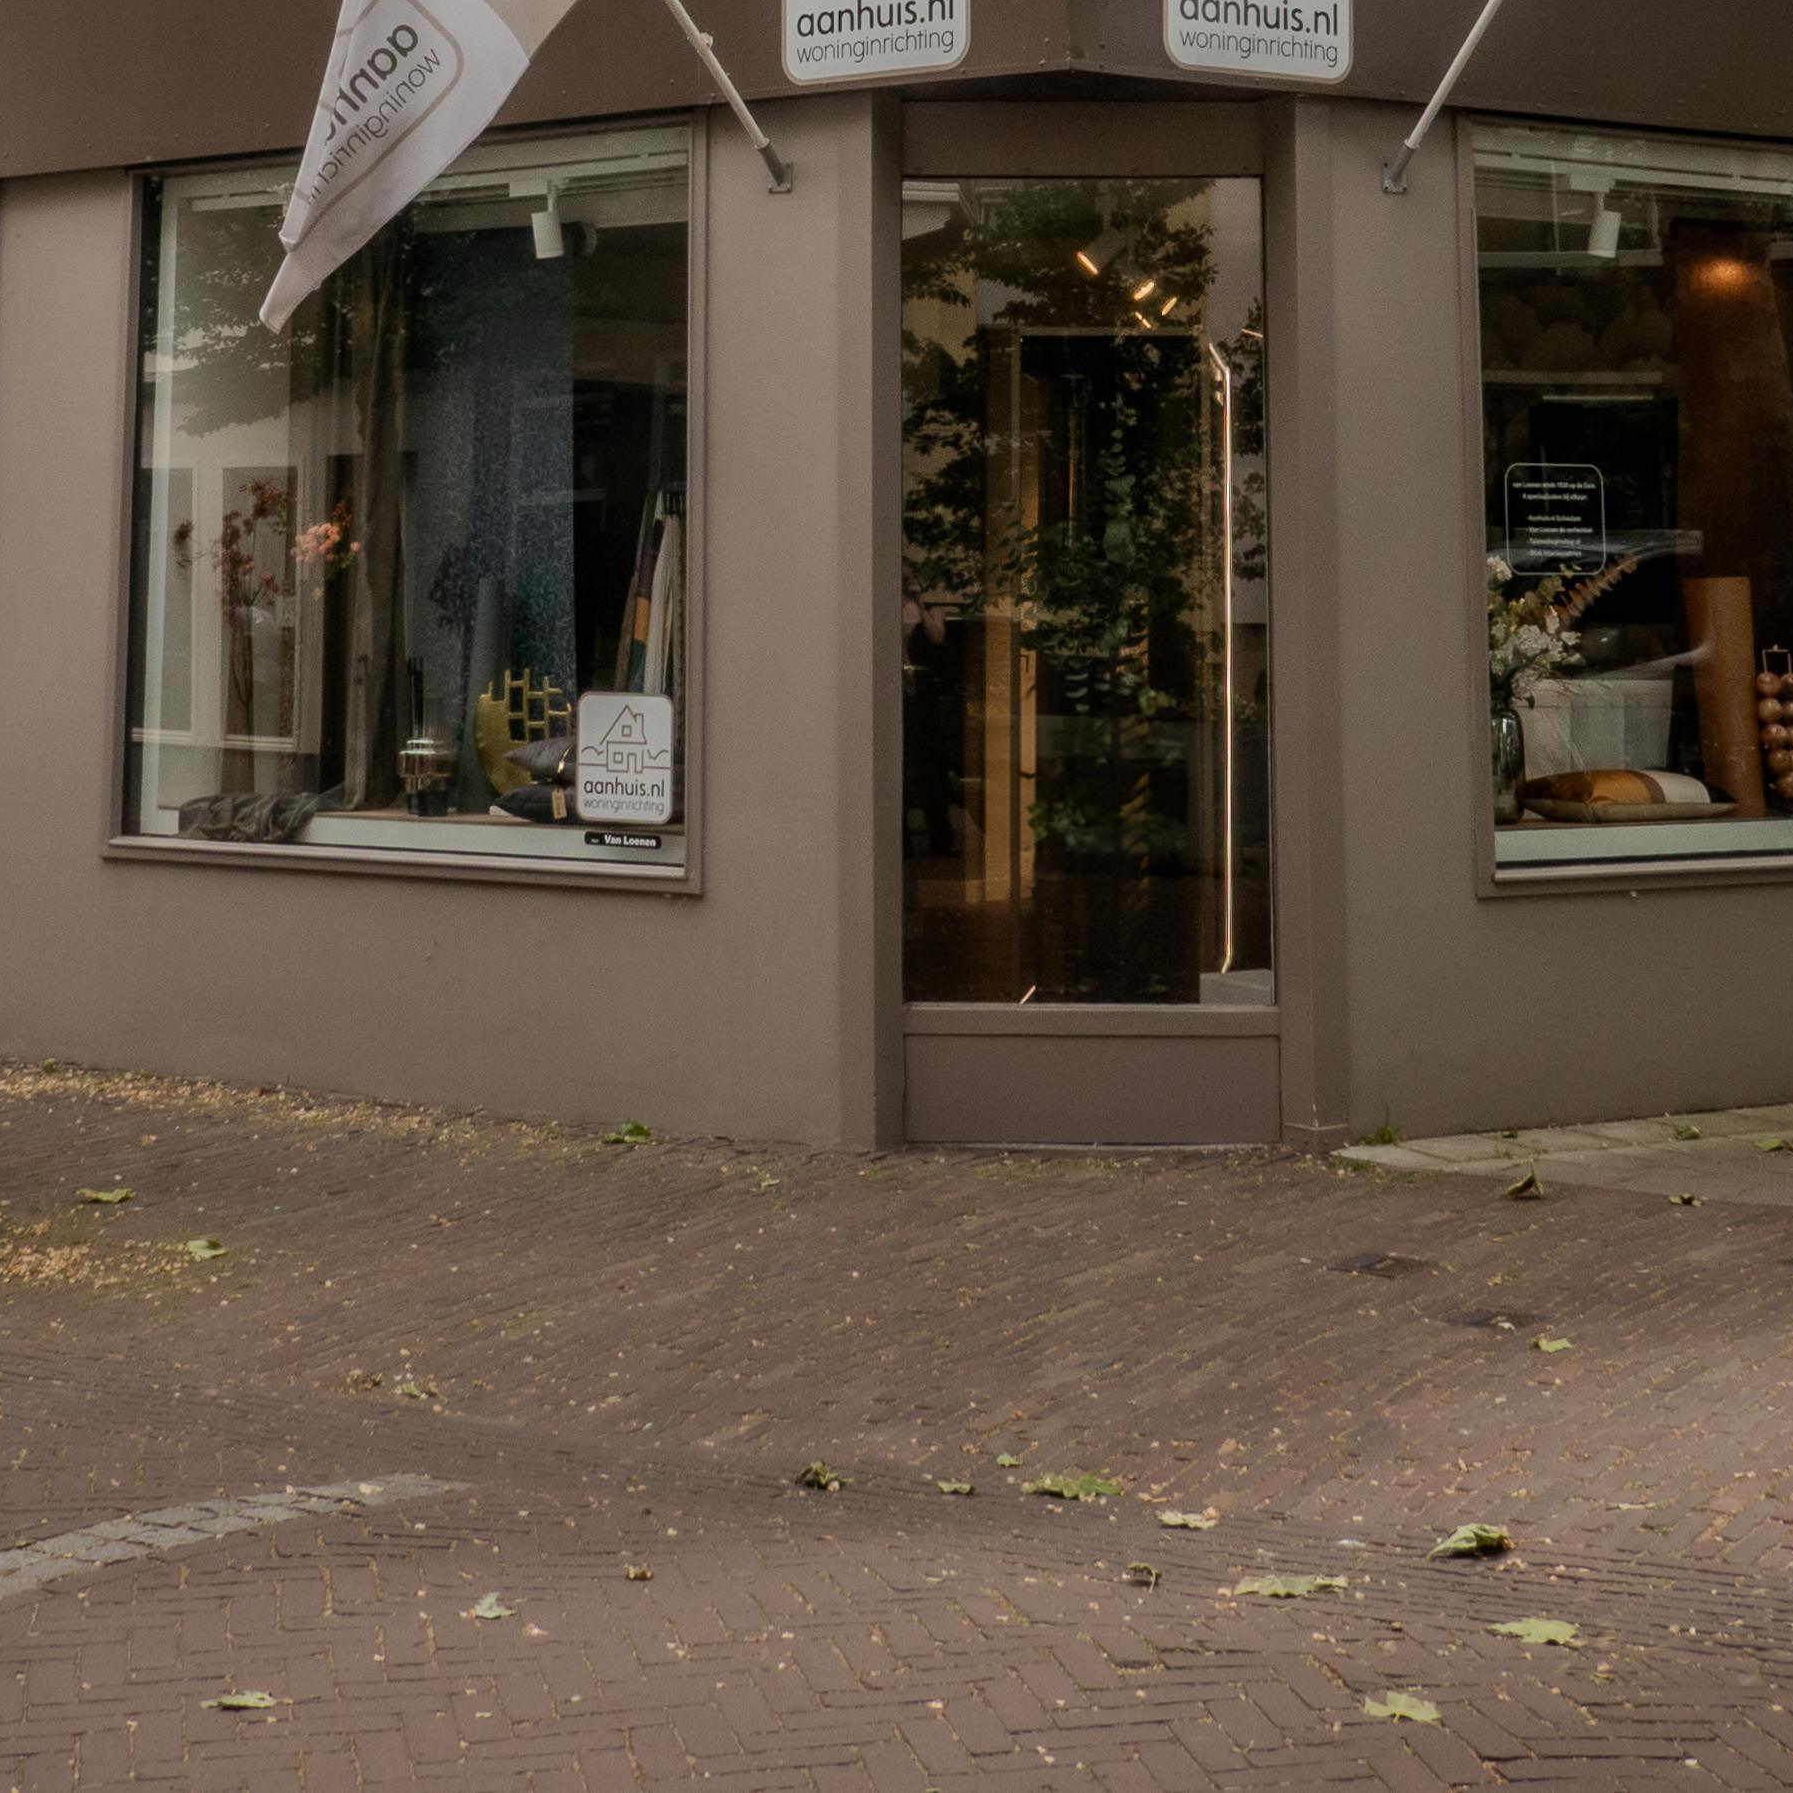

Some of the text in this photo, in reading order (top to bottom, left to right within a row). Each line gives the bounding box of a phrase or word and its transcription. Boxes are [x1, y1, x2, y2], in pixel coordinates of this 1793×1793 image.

[796, 29, 954, 64] woninginrichting
[1179, 29, 1338, 68] woninginrichting
[583, 776, 665, 797] aanhuis.nl
[604, 834, 622, 845] Van
[623, 835, 657, 847] Loenen
